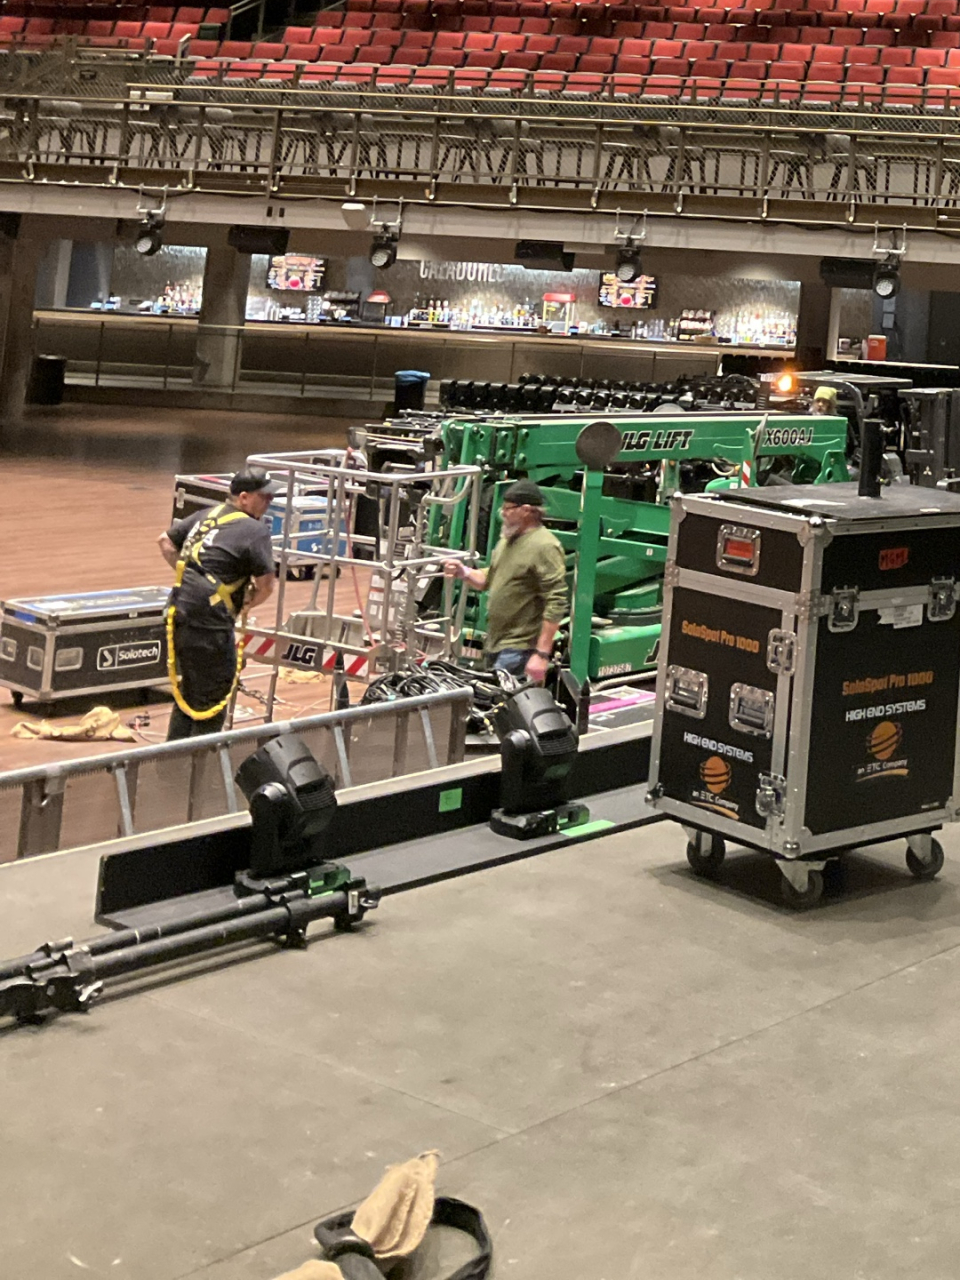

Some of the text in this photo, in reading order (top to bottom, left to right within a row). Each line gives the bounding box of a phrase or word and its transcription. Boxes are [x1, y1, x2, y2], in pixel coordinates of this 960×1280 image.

[652, 429, 695, 450] LIFT
[762, 427, 814, 447] X600AJ
[721, 630, 735, 646] Pro
[736, 635, 760, 653] 1000
[118, 646, 158, 660] Solotech
[281, 643, 318, 666] JLG
[889, 674, 905, 688] Pro
[907, 671, 934, 686] 1000
[845, 699, 926, 722] HIGH END SYSTEMS
[683, 731, 754, 762] HIGH END SYSTEMS
[866, 762, 881, 772] ETC
[700, 791, 714, 802] ETC
